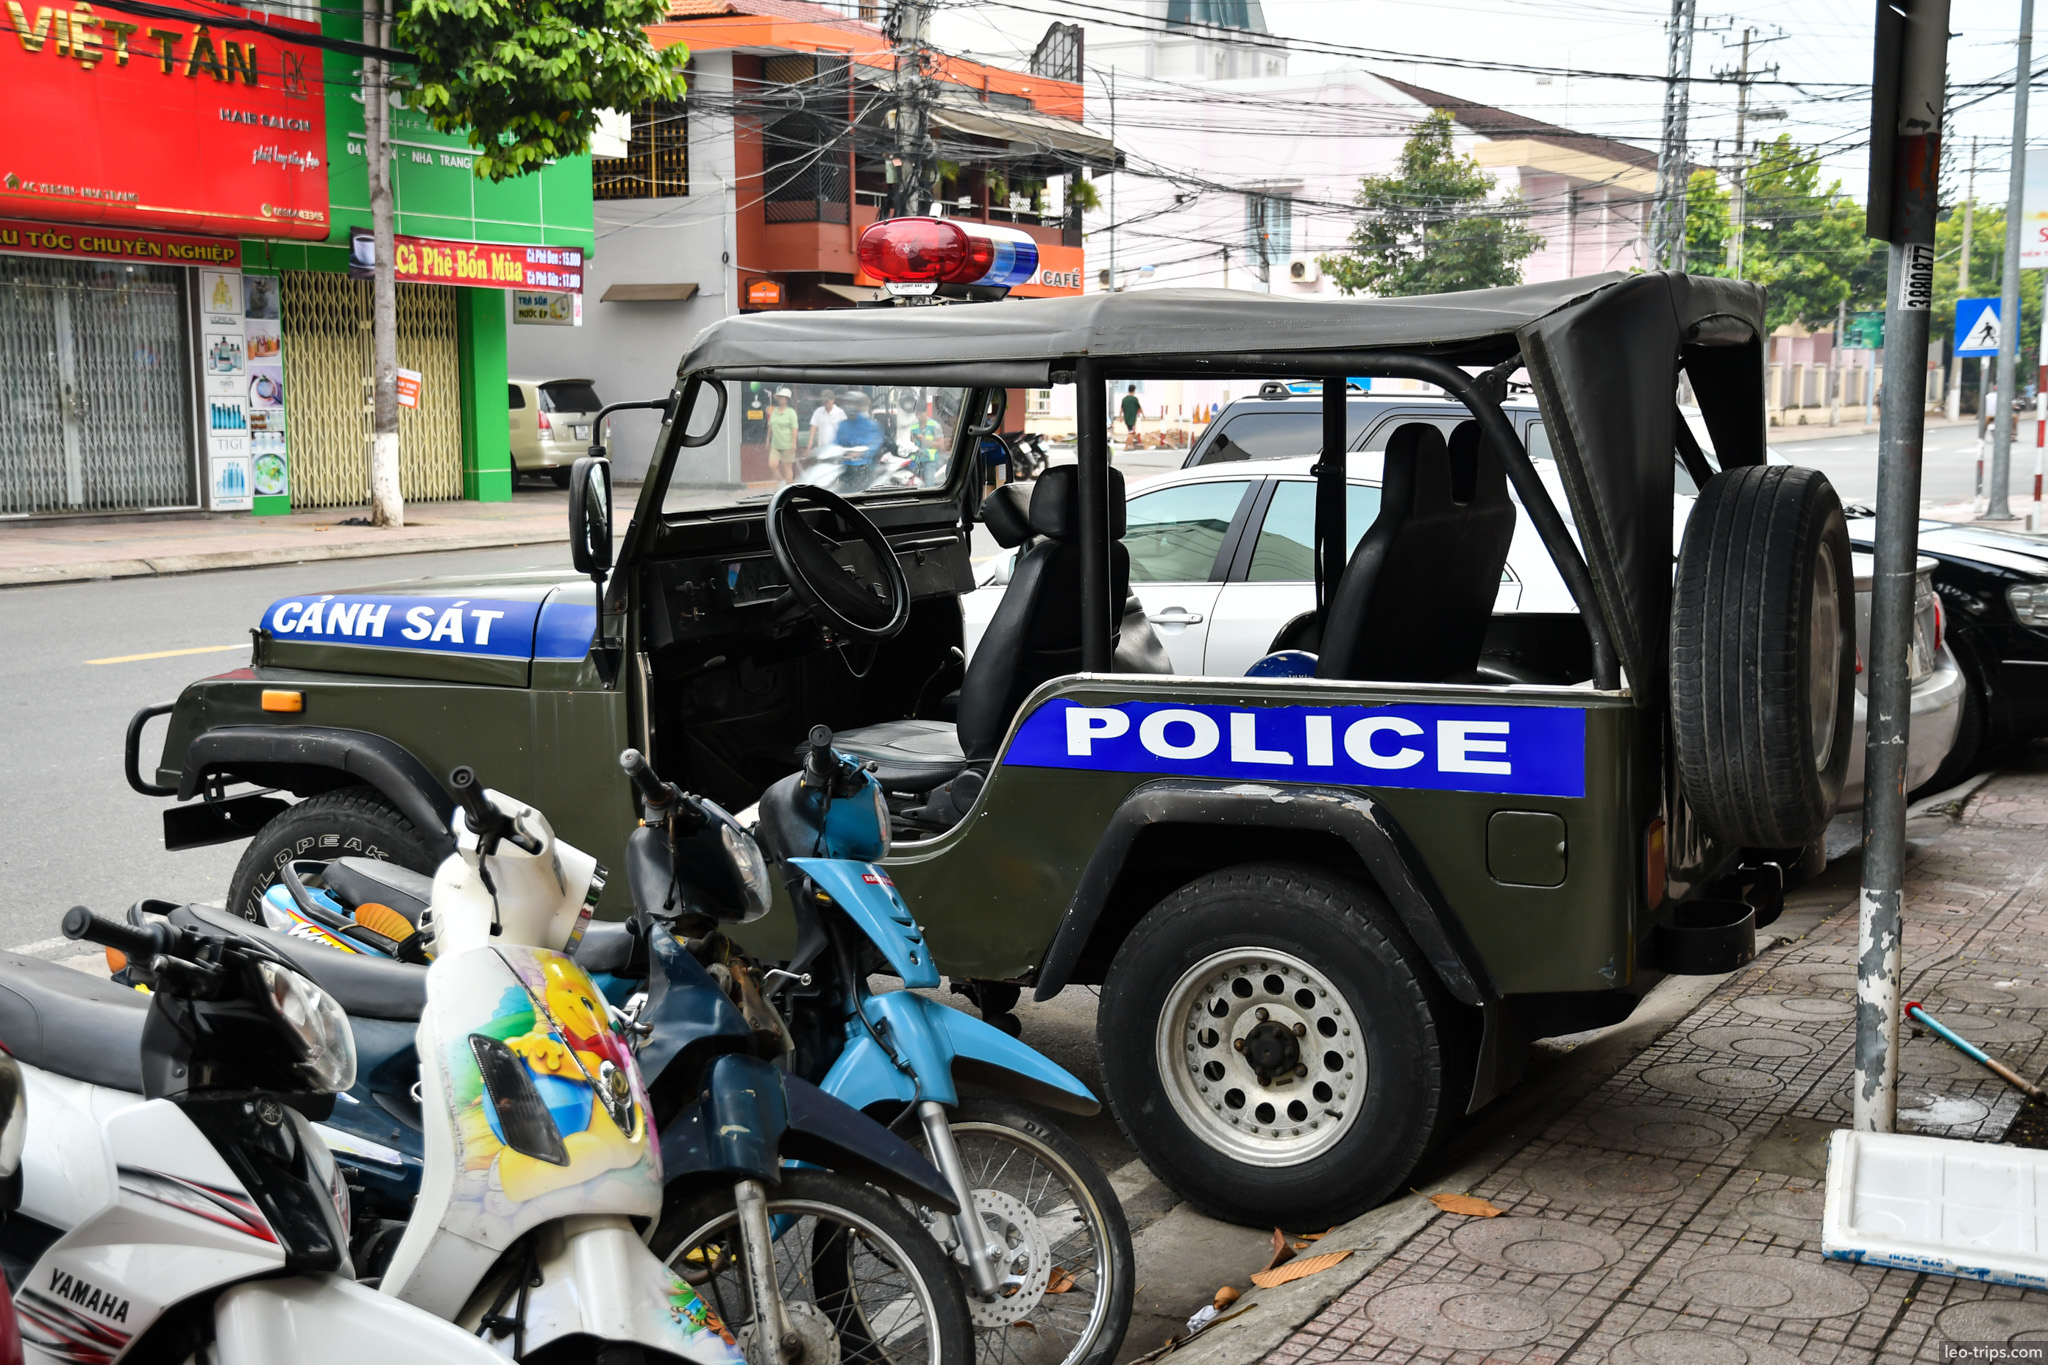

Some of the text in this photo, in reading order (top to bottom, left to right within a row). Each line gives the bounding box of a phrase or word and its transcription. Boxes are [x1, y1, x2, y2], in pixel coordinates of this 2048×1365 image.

[5, 0, 259, 86] VIỆT TÂN
[220, 108, 311, 132] HAIR SALON
[347, 143, 361, 156] 04
[411, 151, 433, 166] NHA
[440, 154, 471, 169] TRANG
[25, 228, 73, 250] TÓC
[79, 236, 162, 257] CHUYÊN
[168, 242, 236, 266] NGHIỆP
[396, 244, 524, 282] Cà Phê Bốn Mùa
[1042, 268, 1081, 289] CAFÉ
[1907, 245, 1935, 308] 3880877
[217, 439, 242, 450] TIGI
[272, 594, 504, 645] CẢNH SÁT
[1065, 706, 1512, 775] POLICE
[49, 1267, 130, 1323] YAMAHA
